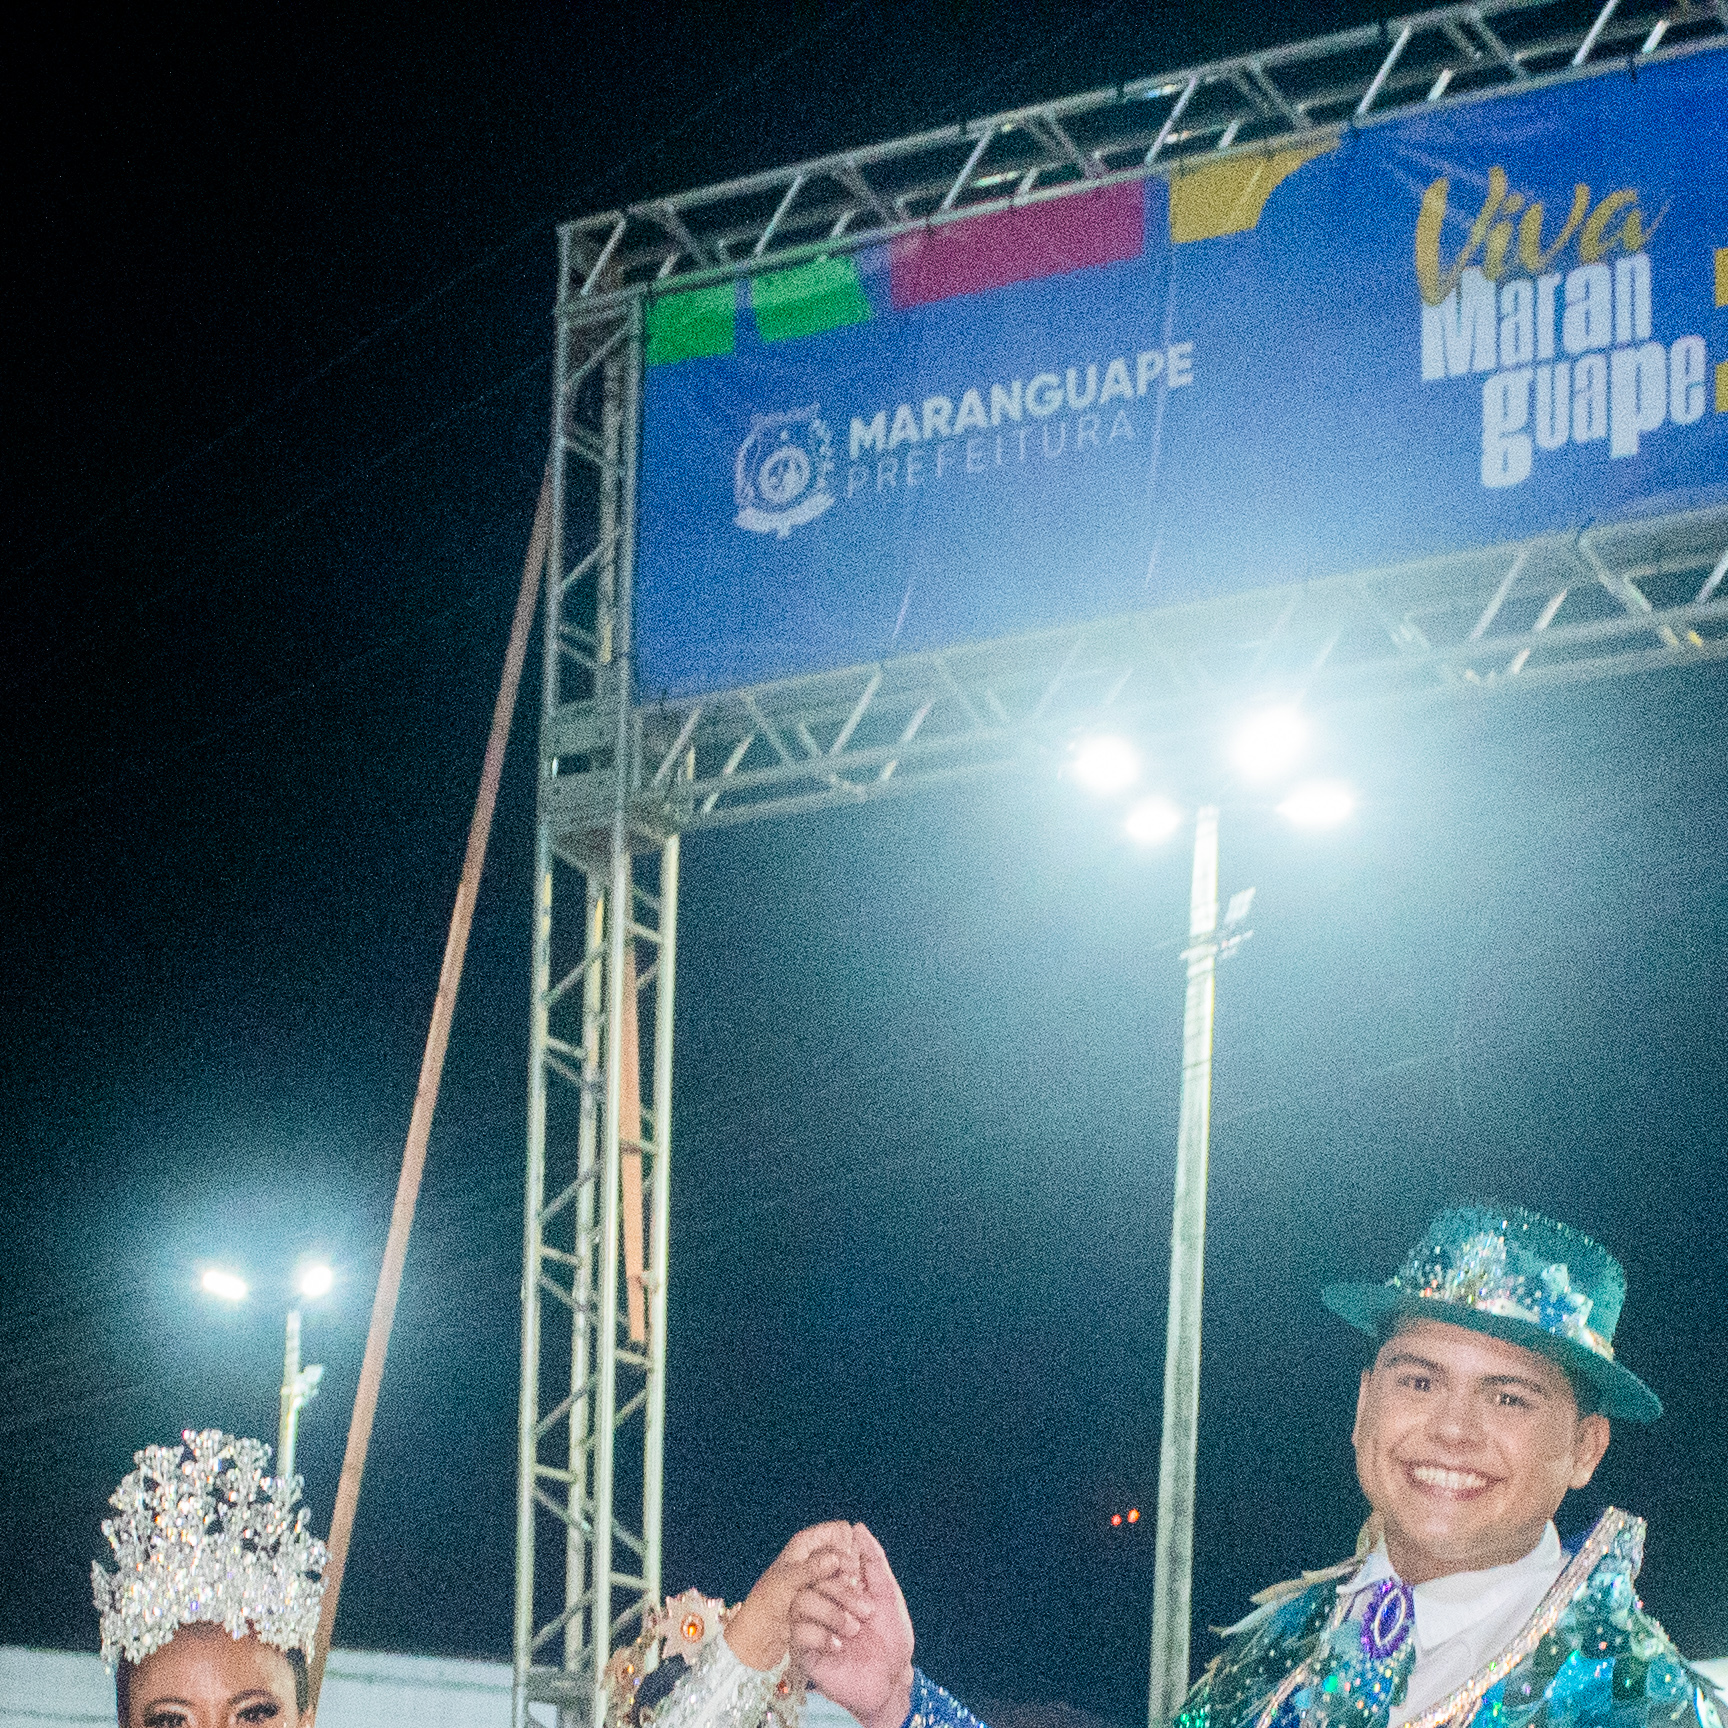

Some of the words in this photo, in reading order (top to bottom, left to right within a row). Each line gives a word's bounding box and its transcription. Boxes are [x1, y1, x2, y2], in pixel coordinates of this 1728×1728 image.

[1415, 165, 1672, 307] Viva
[1421, 252, 1651, 382] Maran
[847, 409, 1135, 500] PREFEITURA
[849, 340, 1194, 461] MARANGUAPE
[1480, 334, 1706, 489] guape
